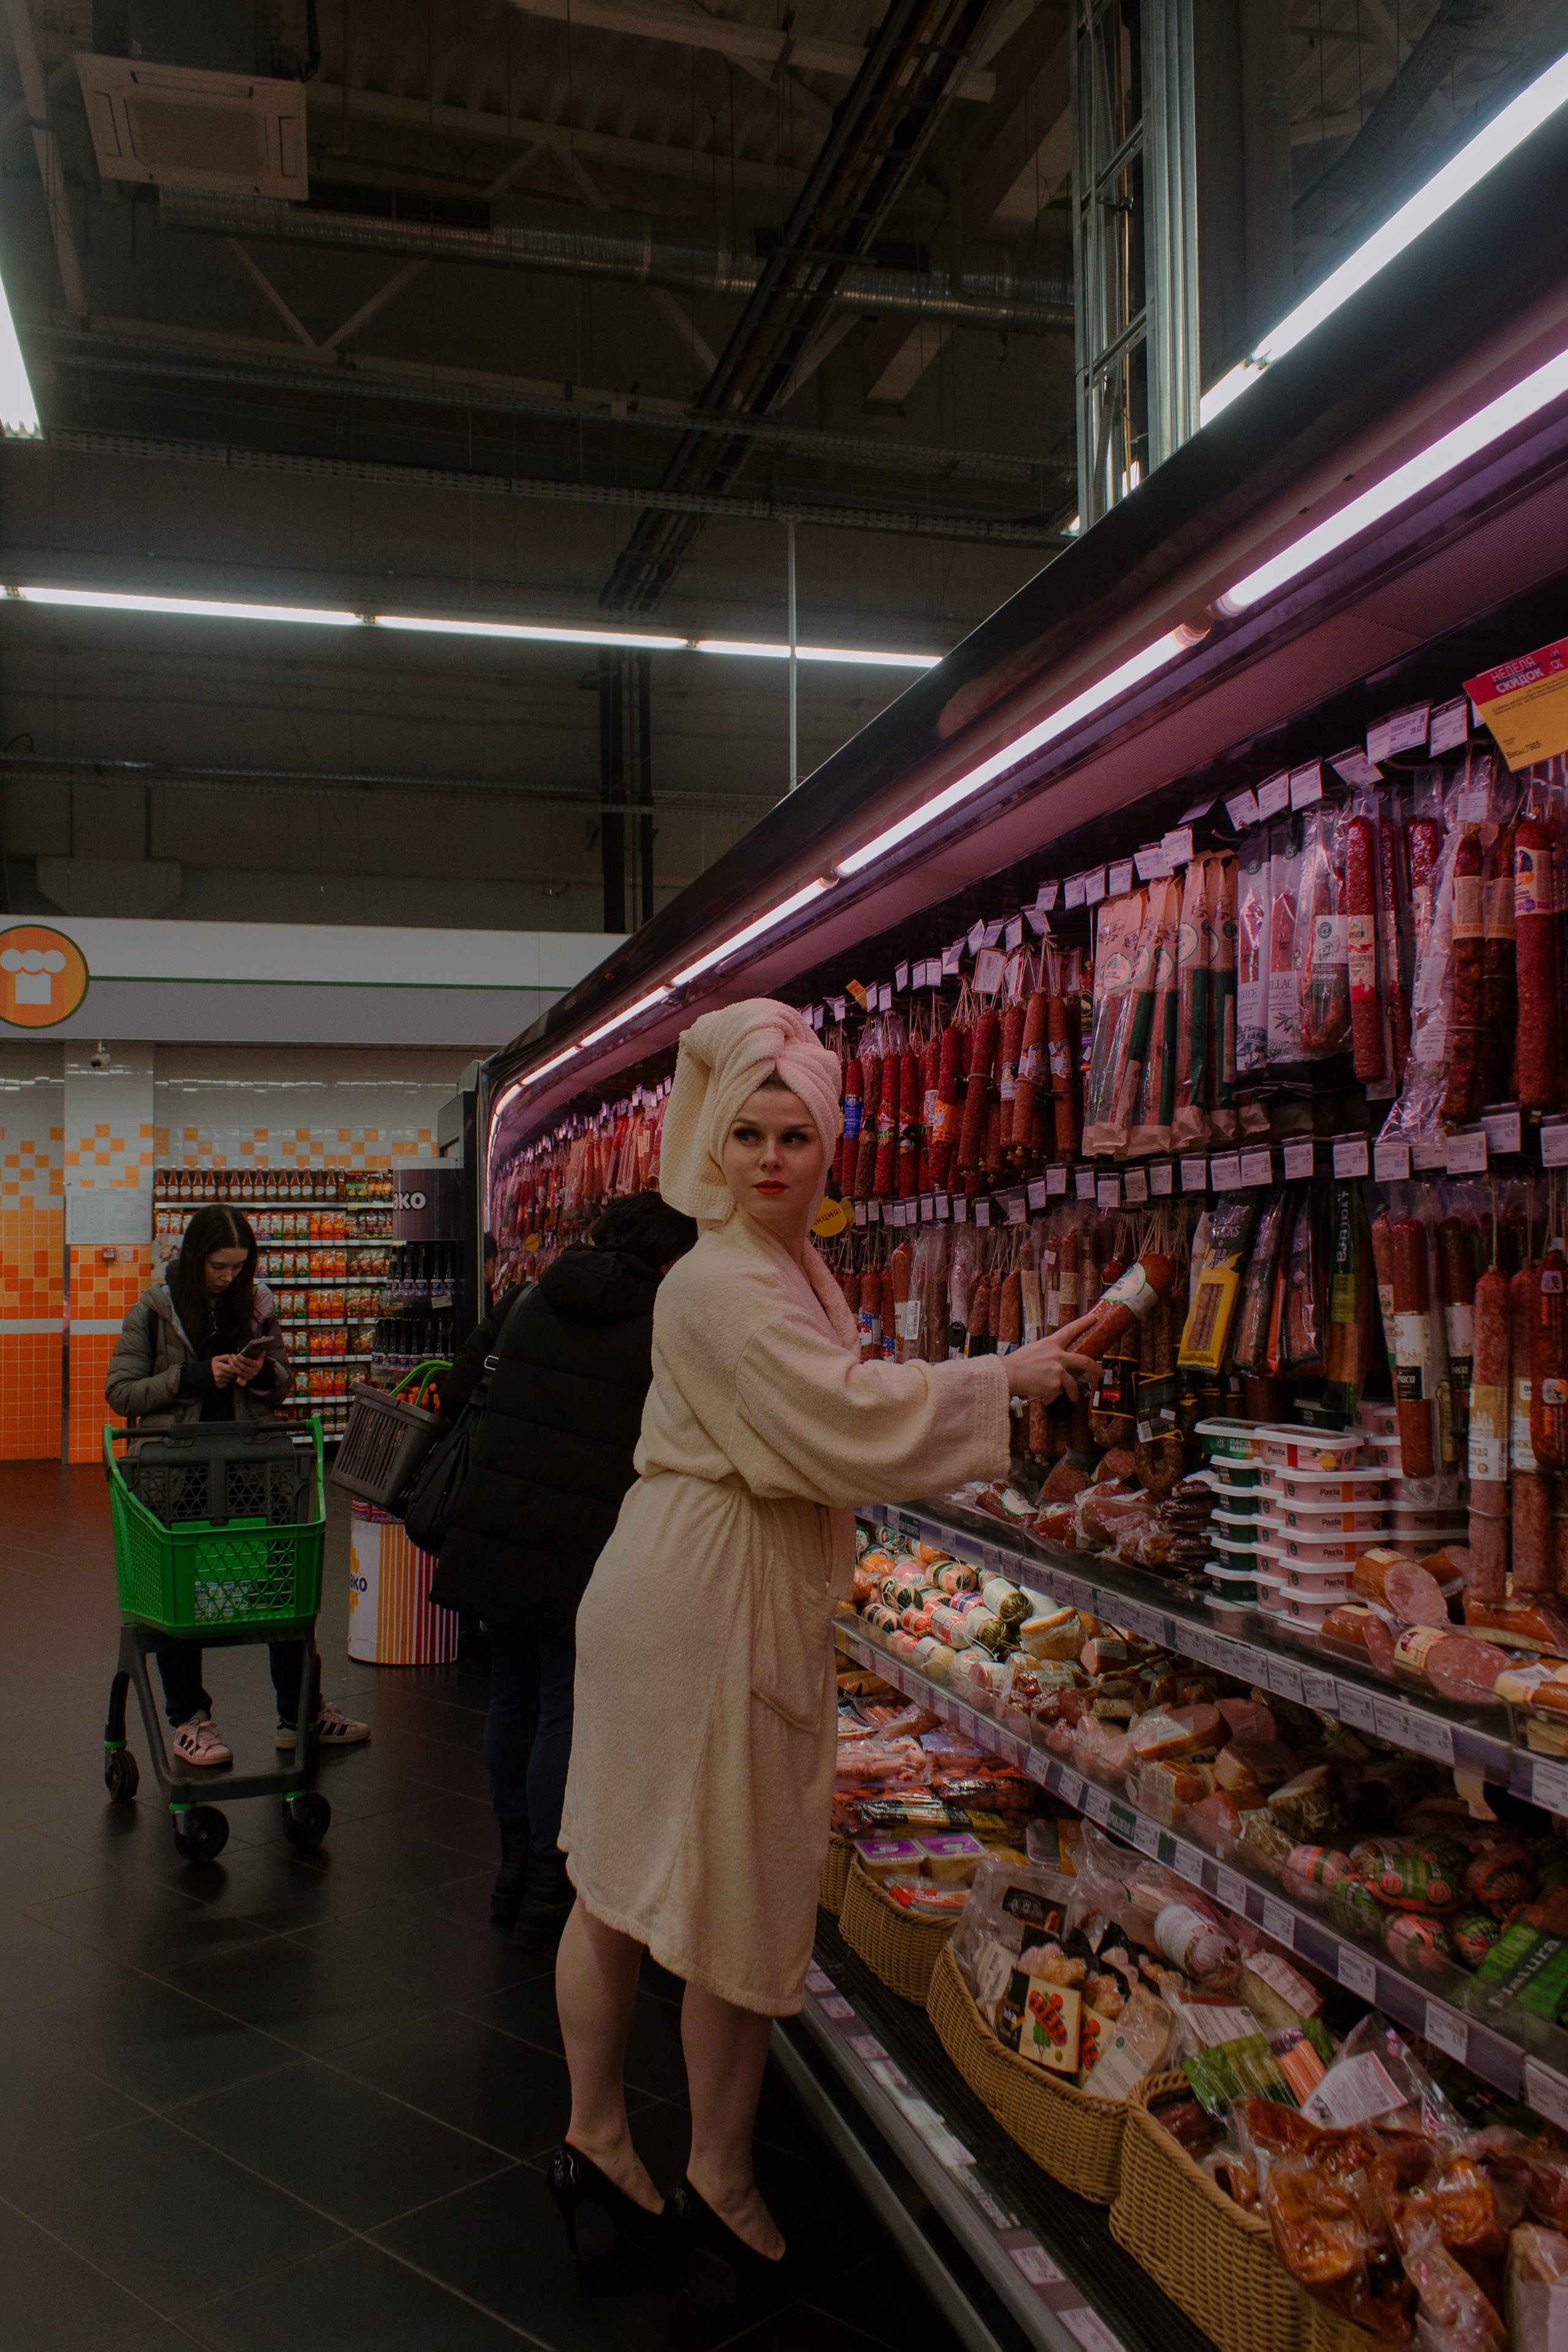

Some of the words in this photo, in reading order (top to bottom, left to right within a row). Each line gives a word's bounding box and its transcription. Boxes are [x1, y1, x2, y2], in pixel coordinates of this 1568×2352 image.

[1490, 656, 1536, 682] НЕДЕЛЯ
[1495, 668, 1544, 693] СКИДОК
[1229, 1439, 1251, 1447] ПАСТА
[1229, 1445, 1253, 1454] МАНИЯ
[1268, 1446, 1286, 1456] Pasta
